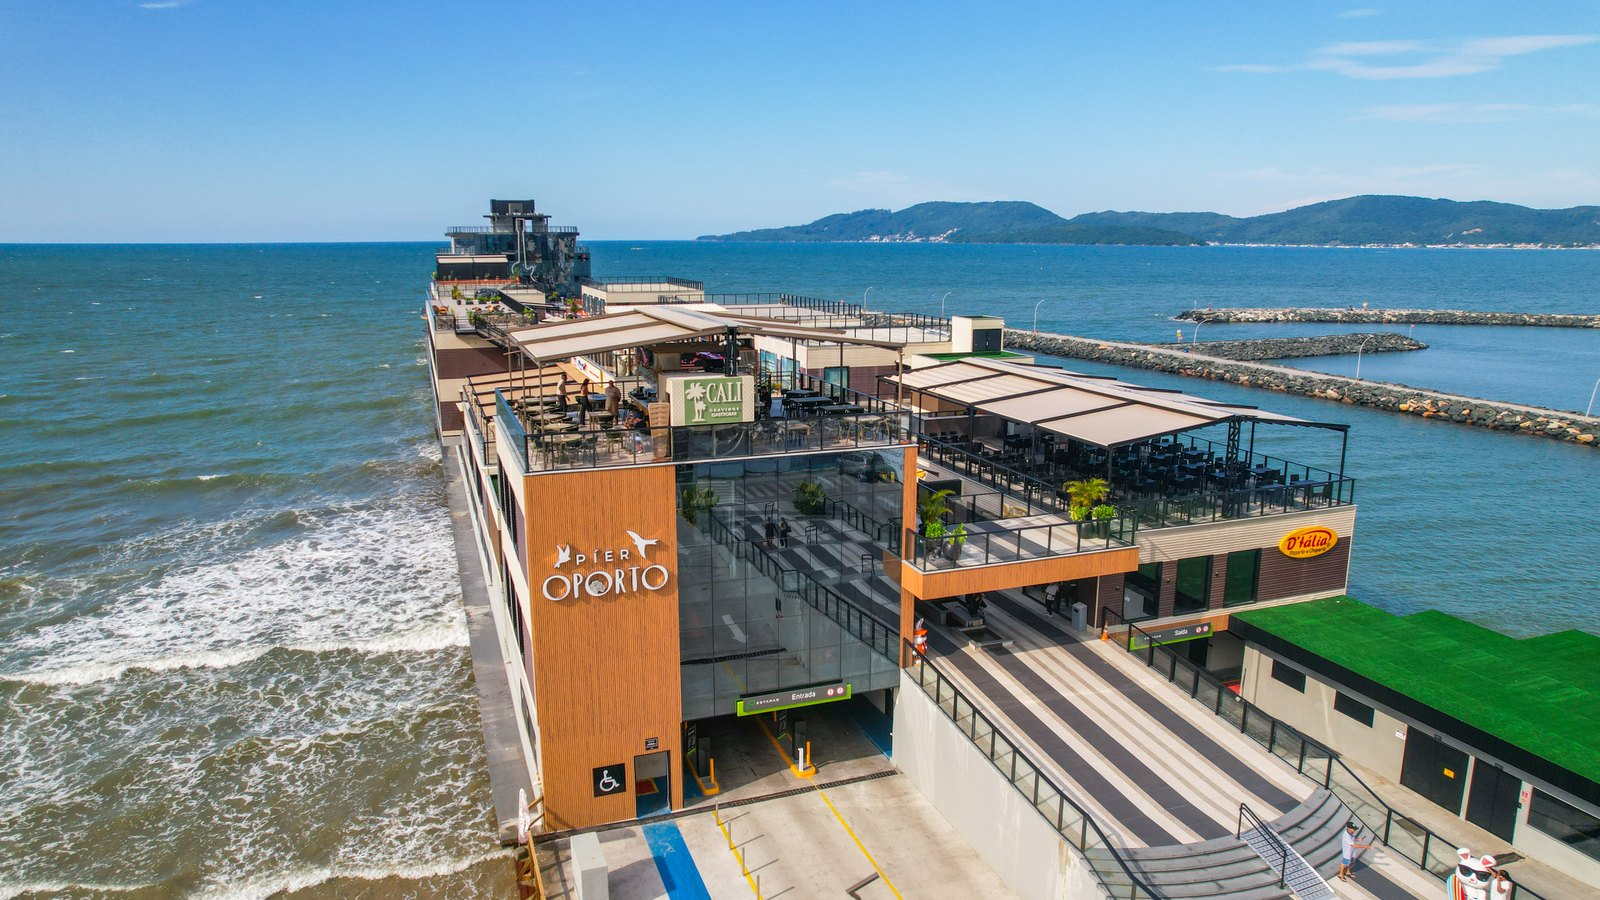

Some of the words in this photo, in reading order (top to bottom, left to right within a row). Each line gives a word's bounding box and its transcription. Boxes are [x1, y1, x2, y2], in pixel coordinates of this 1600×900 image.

[707, 382, 742, 403] CALI
[542, 564, 669, 601] OPORTO
[791, 691, 816, 701] Entrada
